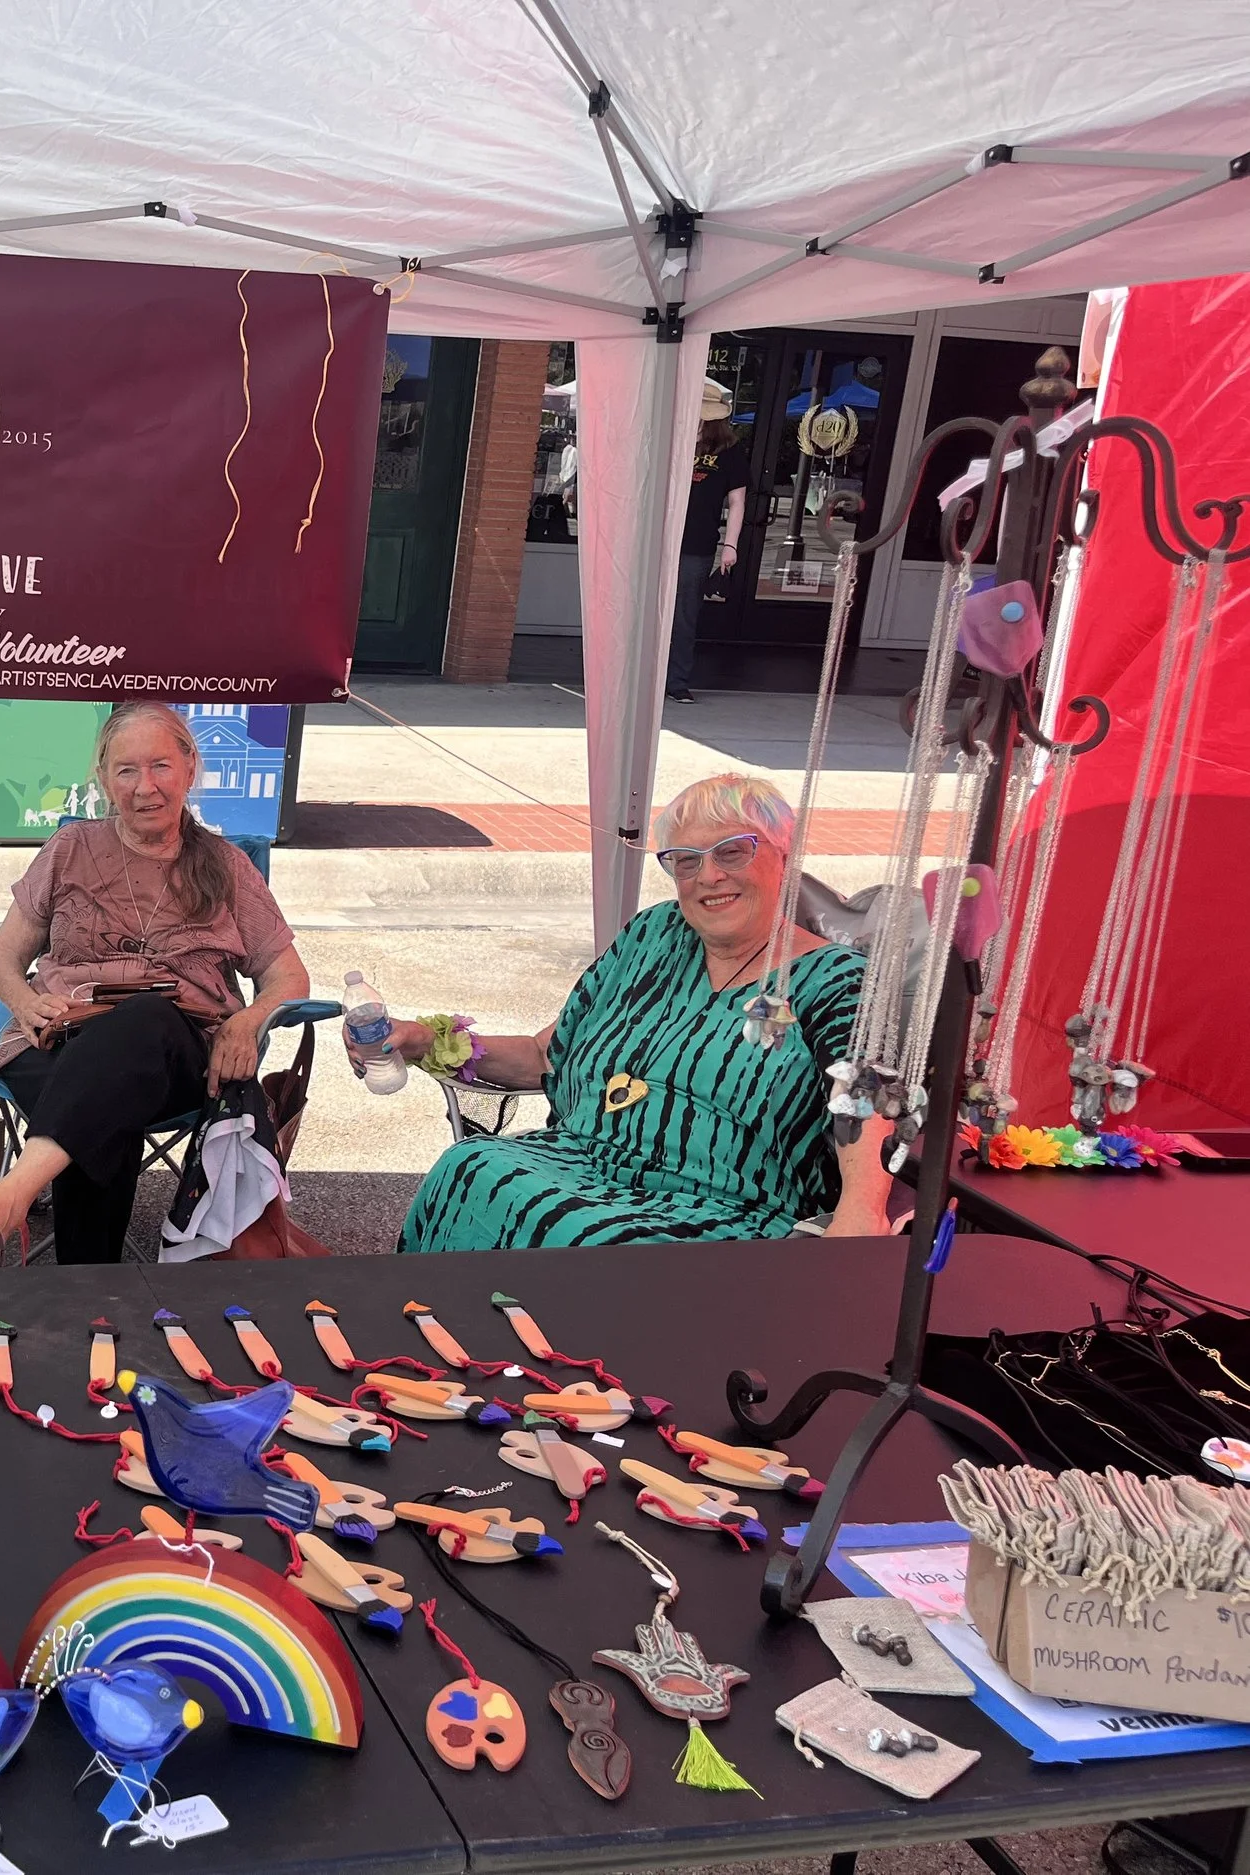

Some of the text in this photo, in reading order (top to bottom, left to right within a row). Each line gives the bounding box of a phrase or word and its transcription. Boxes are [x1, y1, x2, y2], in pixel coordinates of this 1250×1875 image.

[816, 420, 842, 434] d20
[2, 430, 52, 452] 2015
[897, 1571, 950, 1586] Kiba
[1033, 1646, 1151, 1675] MUSHROOM
